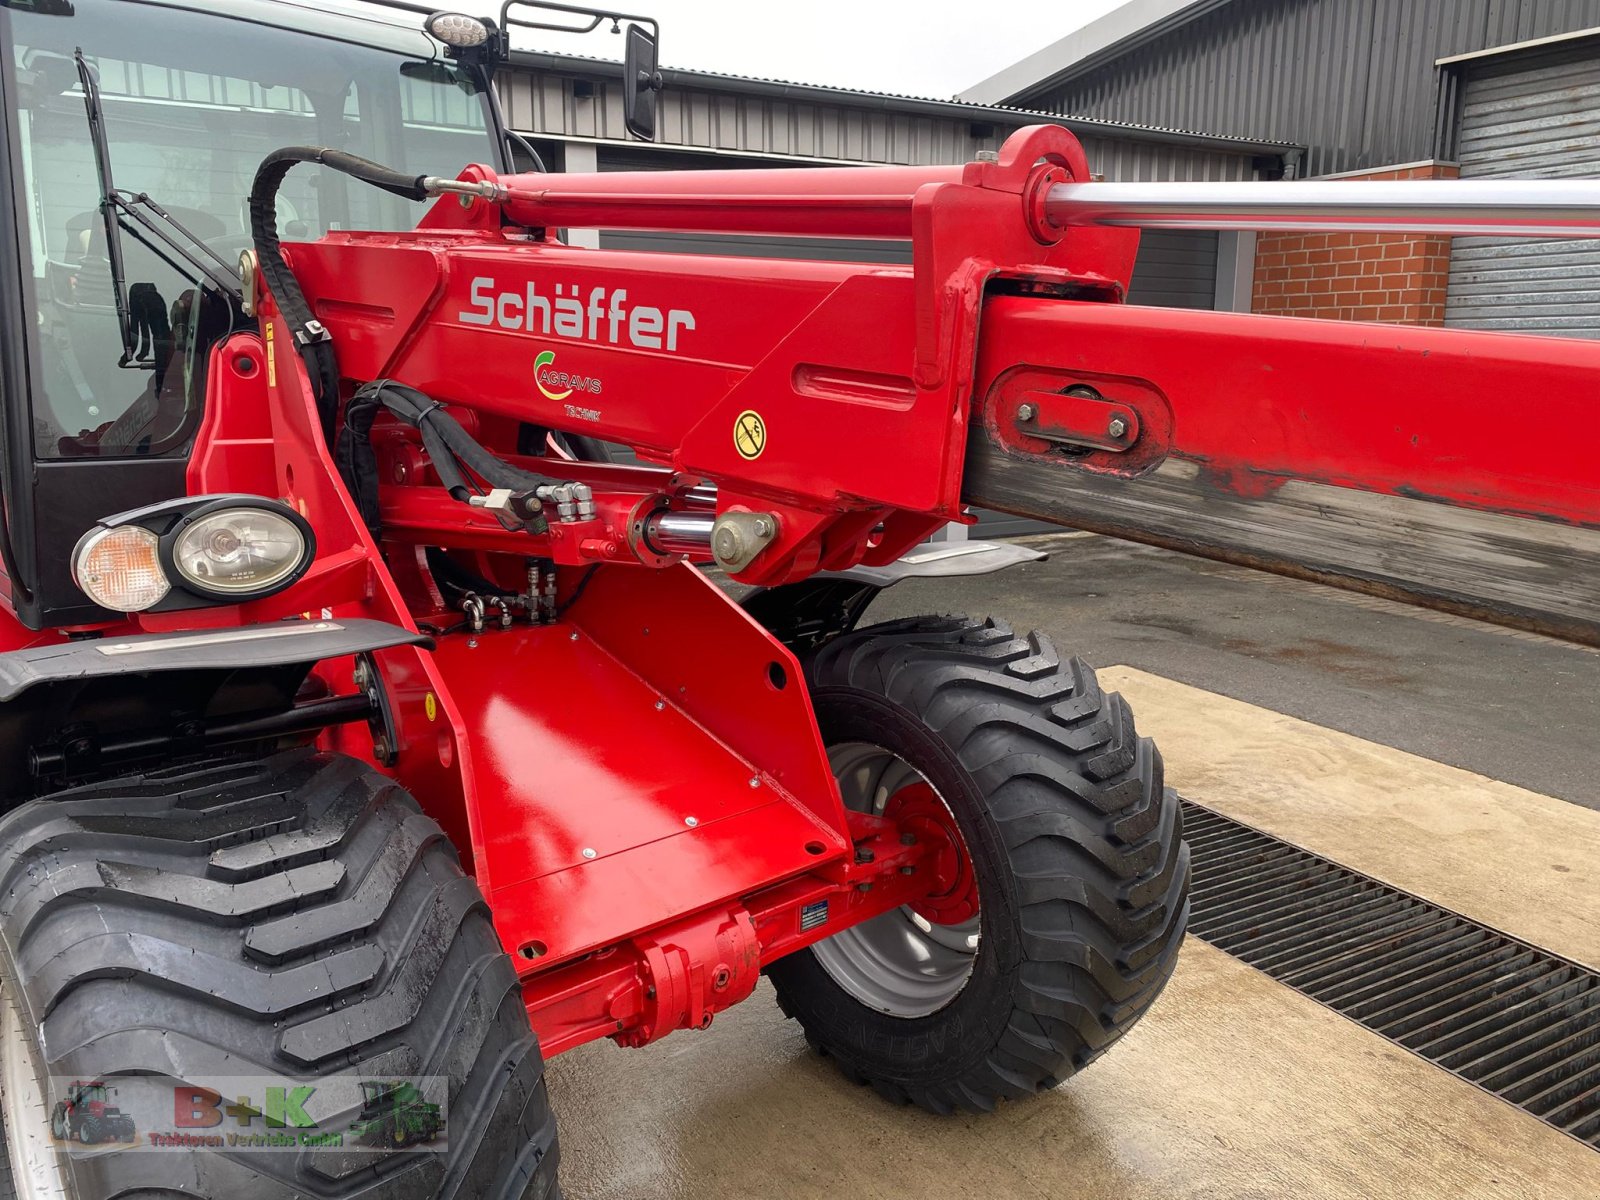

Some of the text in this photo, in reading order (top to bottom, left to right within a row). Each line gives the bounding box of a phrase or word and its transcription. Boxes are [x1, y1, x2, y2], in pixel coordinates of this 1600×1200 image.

[459, 277, 696, 351] Schäffer
[539, 369, 602, 395] AGRAVIS
[564, 404, 602, 423] TECHNIK
